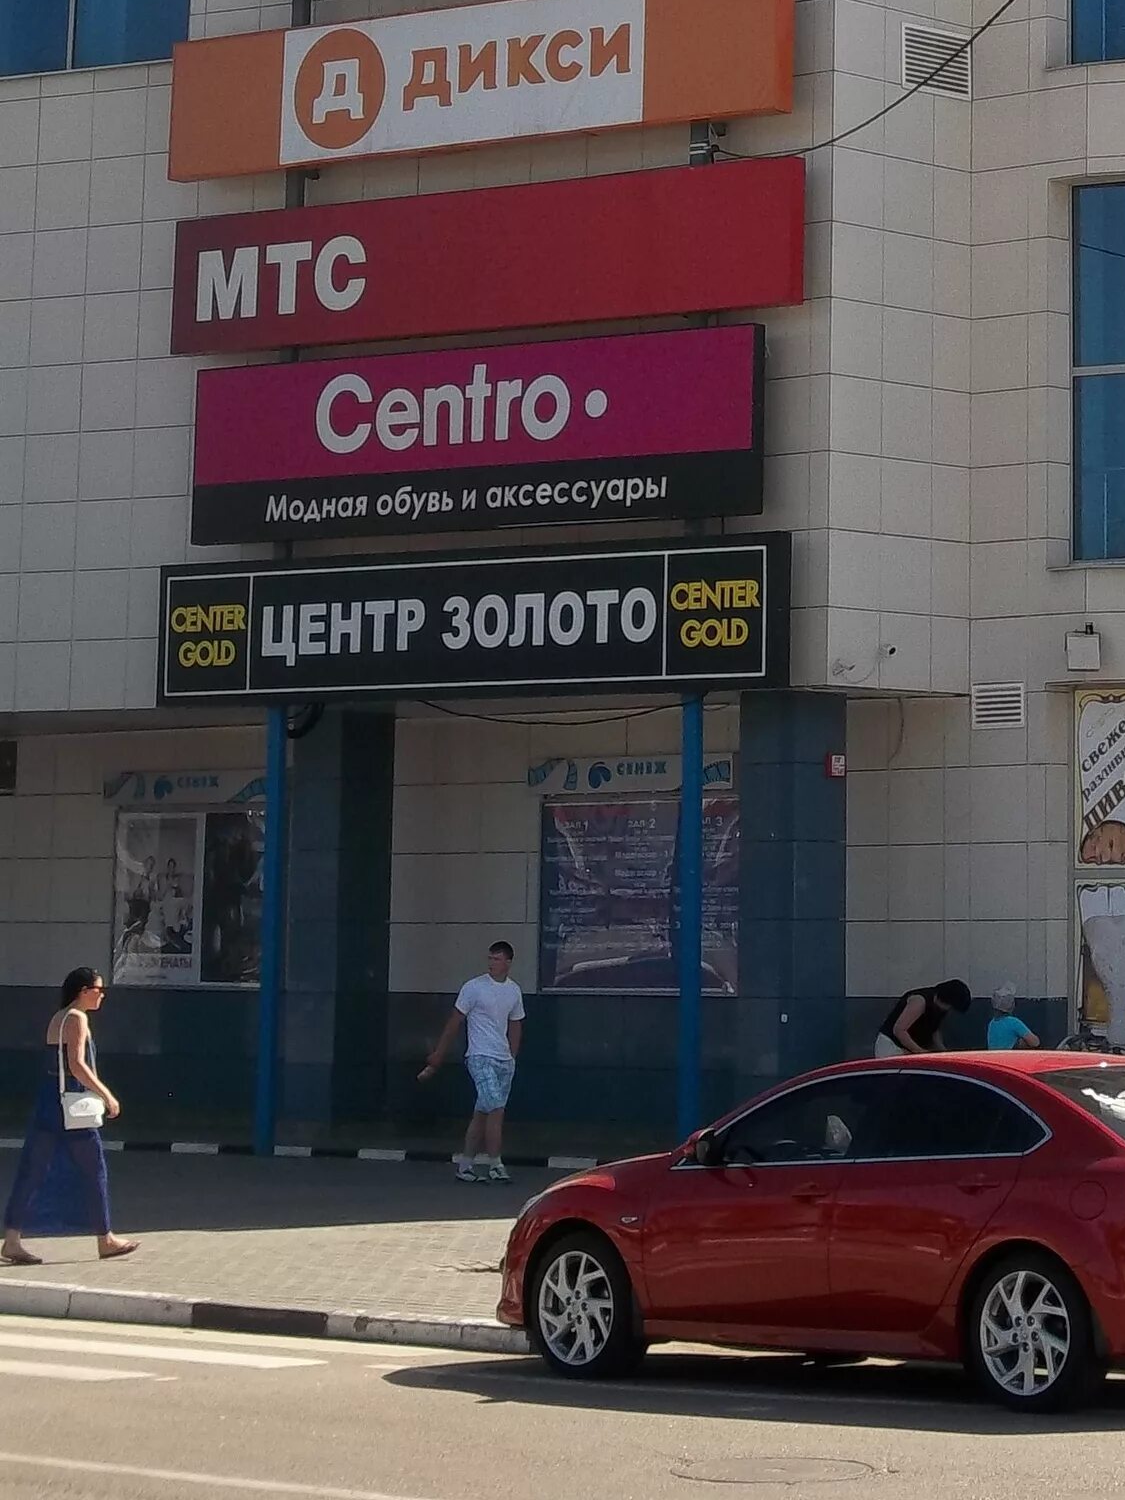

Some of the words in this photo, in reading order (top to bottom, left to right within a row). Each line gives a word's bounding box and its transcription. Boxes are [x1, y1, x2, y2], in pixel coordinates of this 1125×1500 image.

[195, 234, 367, 322] МТС
[315, 363, 572, 454] Centro
[265, 492, 367, 524] Модная
[375, 485, 453, 517] обувь
[461, 489, 476, 511] и
[485, 472, 668, 510] аксессуары
[670, 578, 760, 612] CENTER
[170, 603, 246, 635] CENTER
[260, 597, 426, 666] ЦЕНТР
[441, 587, 657, 651] ЗОЛОТО
[679, 618, 749, 648] GOLD
[178, 640, 236, 668] GOLD
[616, 760, 667, 776] СЕНЕЖ
